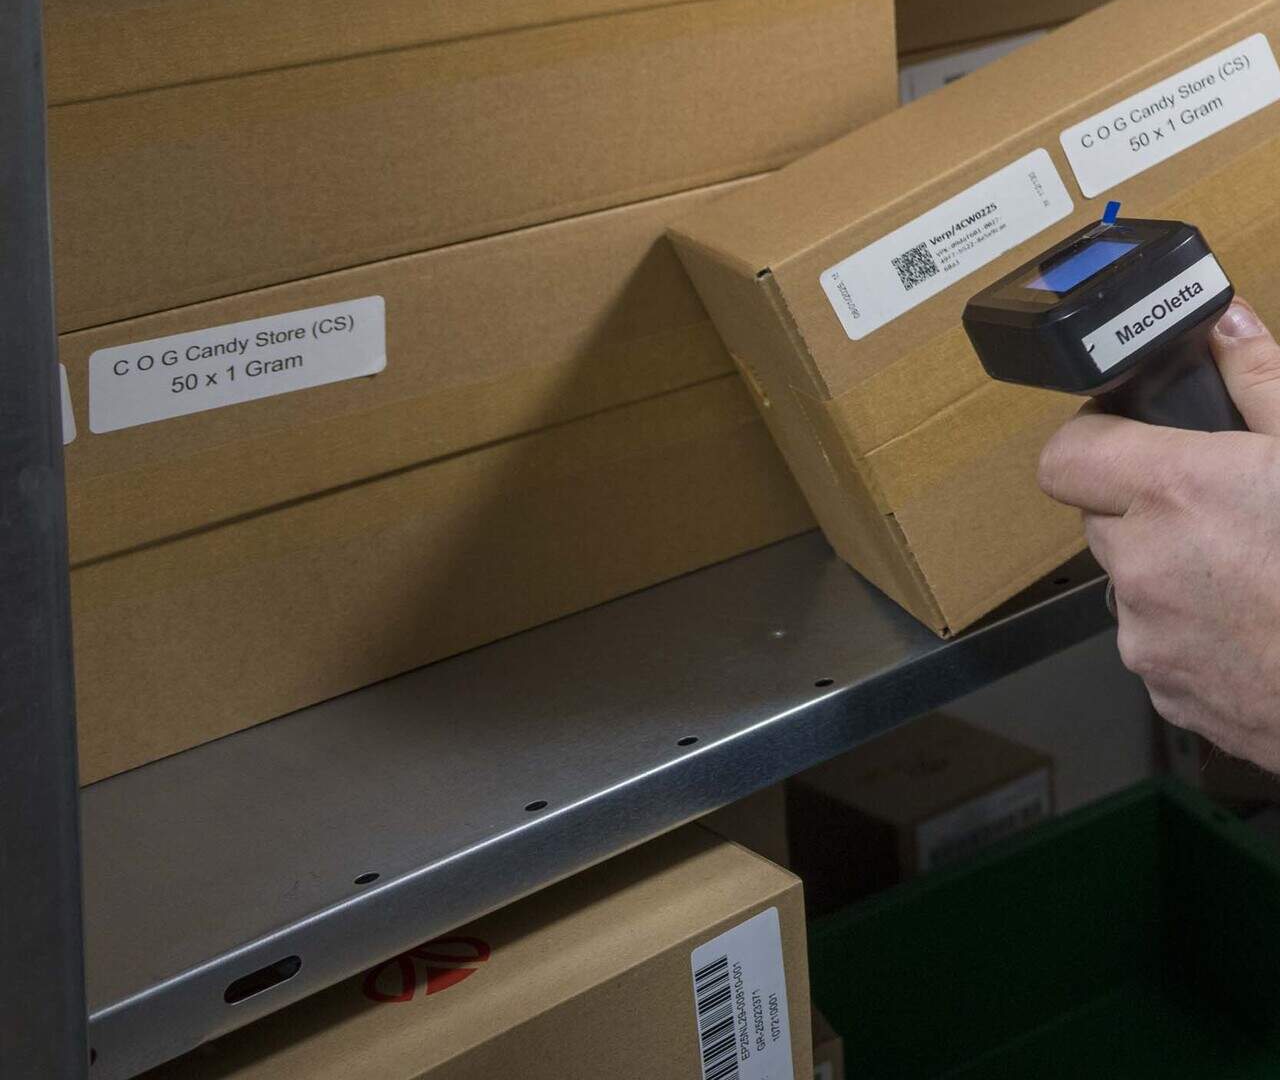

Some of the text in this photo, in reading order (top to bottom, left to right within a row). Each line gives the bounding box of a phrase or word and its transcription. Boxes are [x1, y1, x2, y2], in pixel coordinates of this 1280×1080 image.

[1081, 54, 1251, 149] C O G Candy Store (CS)
[1129, 96, 1224, 152] 50 x 1 Gram
[929, 202, 998, 246] Verp/4CW0225
[1115, 279, 1204, 346] MacOletta
[113, 314, 354, 376] C O G Candy Store (CS)
[171, 354, 303, 394] 50 x 1 Gram
